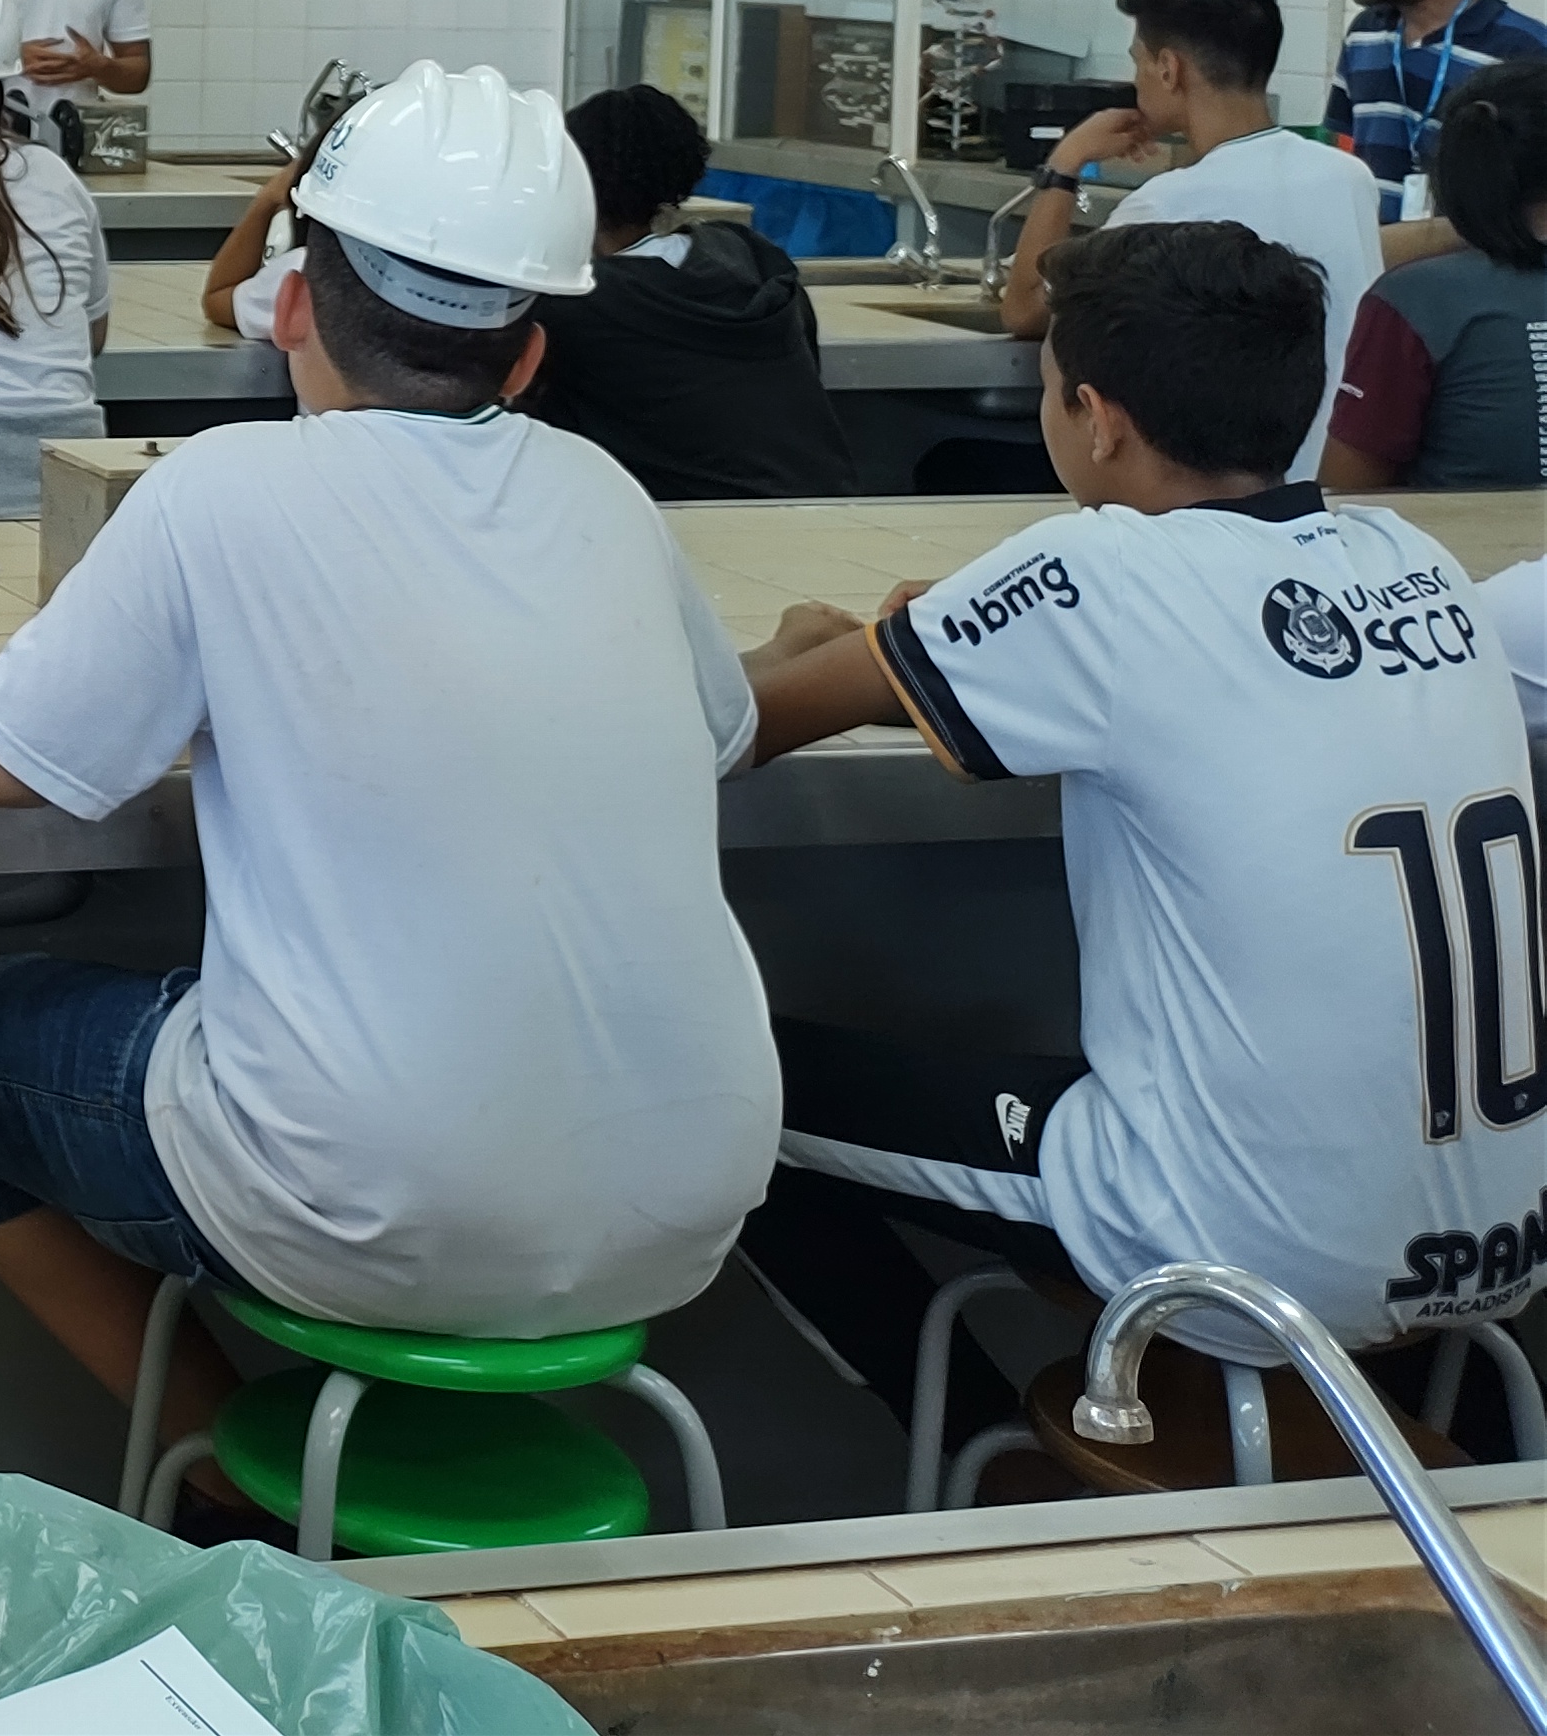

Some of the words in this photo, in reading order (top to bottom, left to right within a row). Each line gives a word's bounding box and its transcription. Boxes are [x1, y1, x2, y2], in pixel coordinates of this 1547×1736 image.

[969, 557, 1080, 634] bmg
[1364, 604, 1477, 675] SCCP
[1344, 787, 1547, 1145] 10
[1007, 1101, 1031, 1144] NIKE
[1416, 1277, 1531, 1317] ATACADISTA
